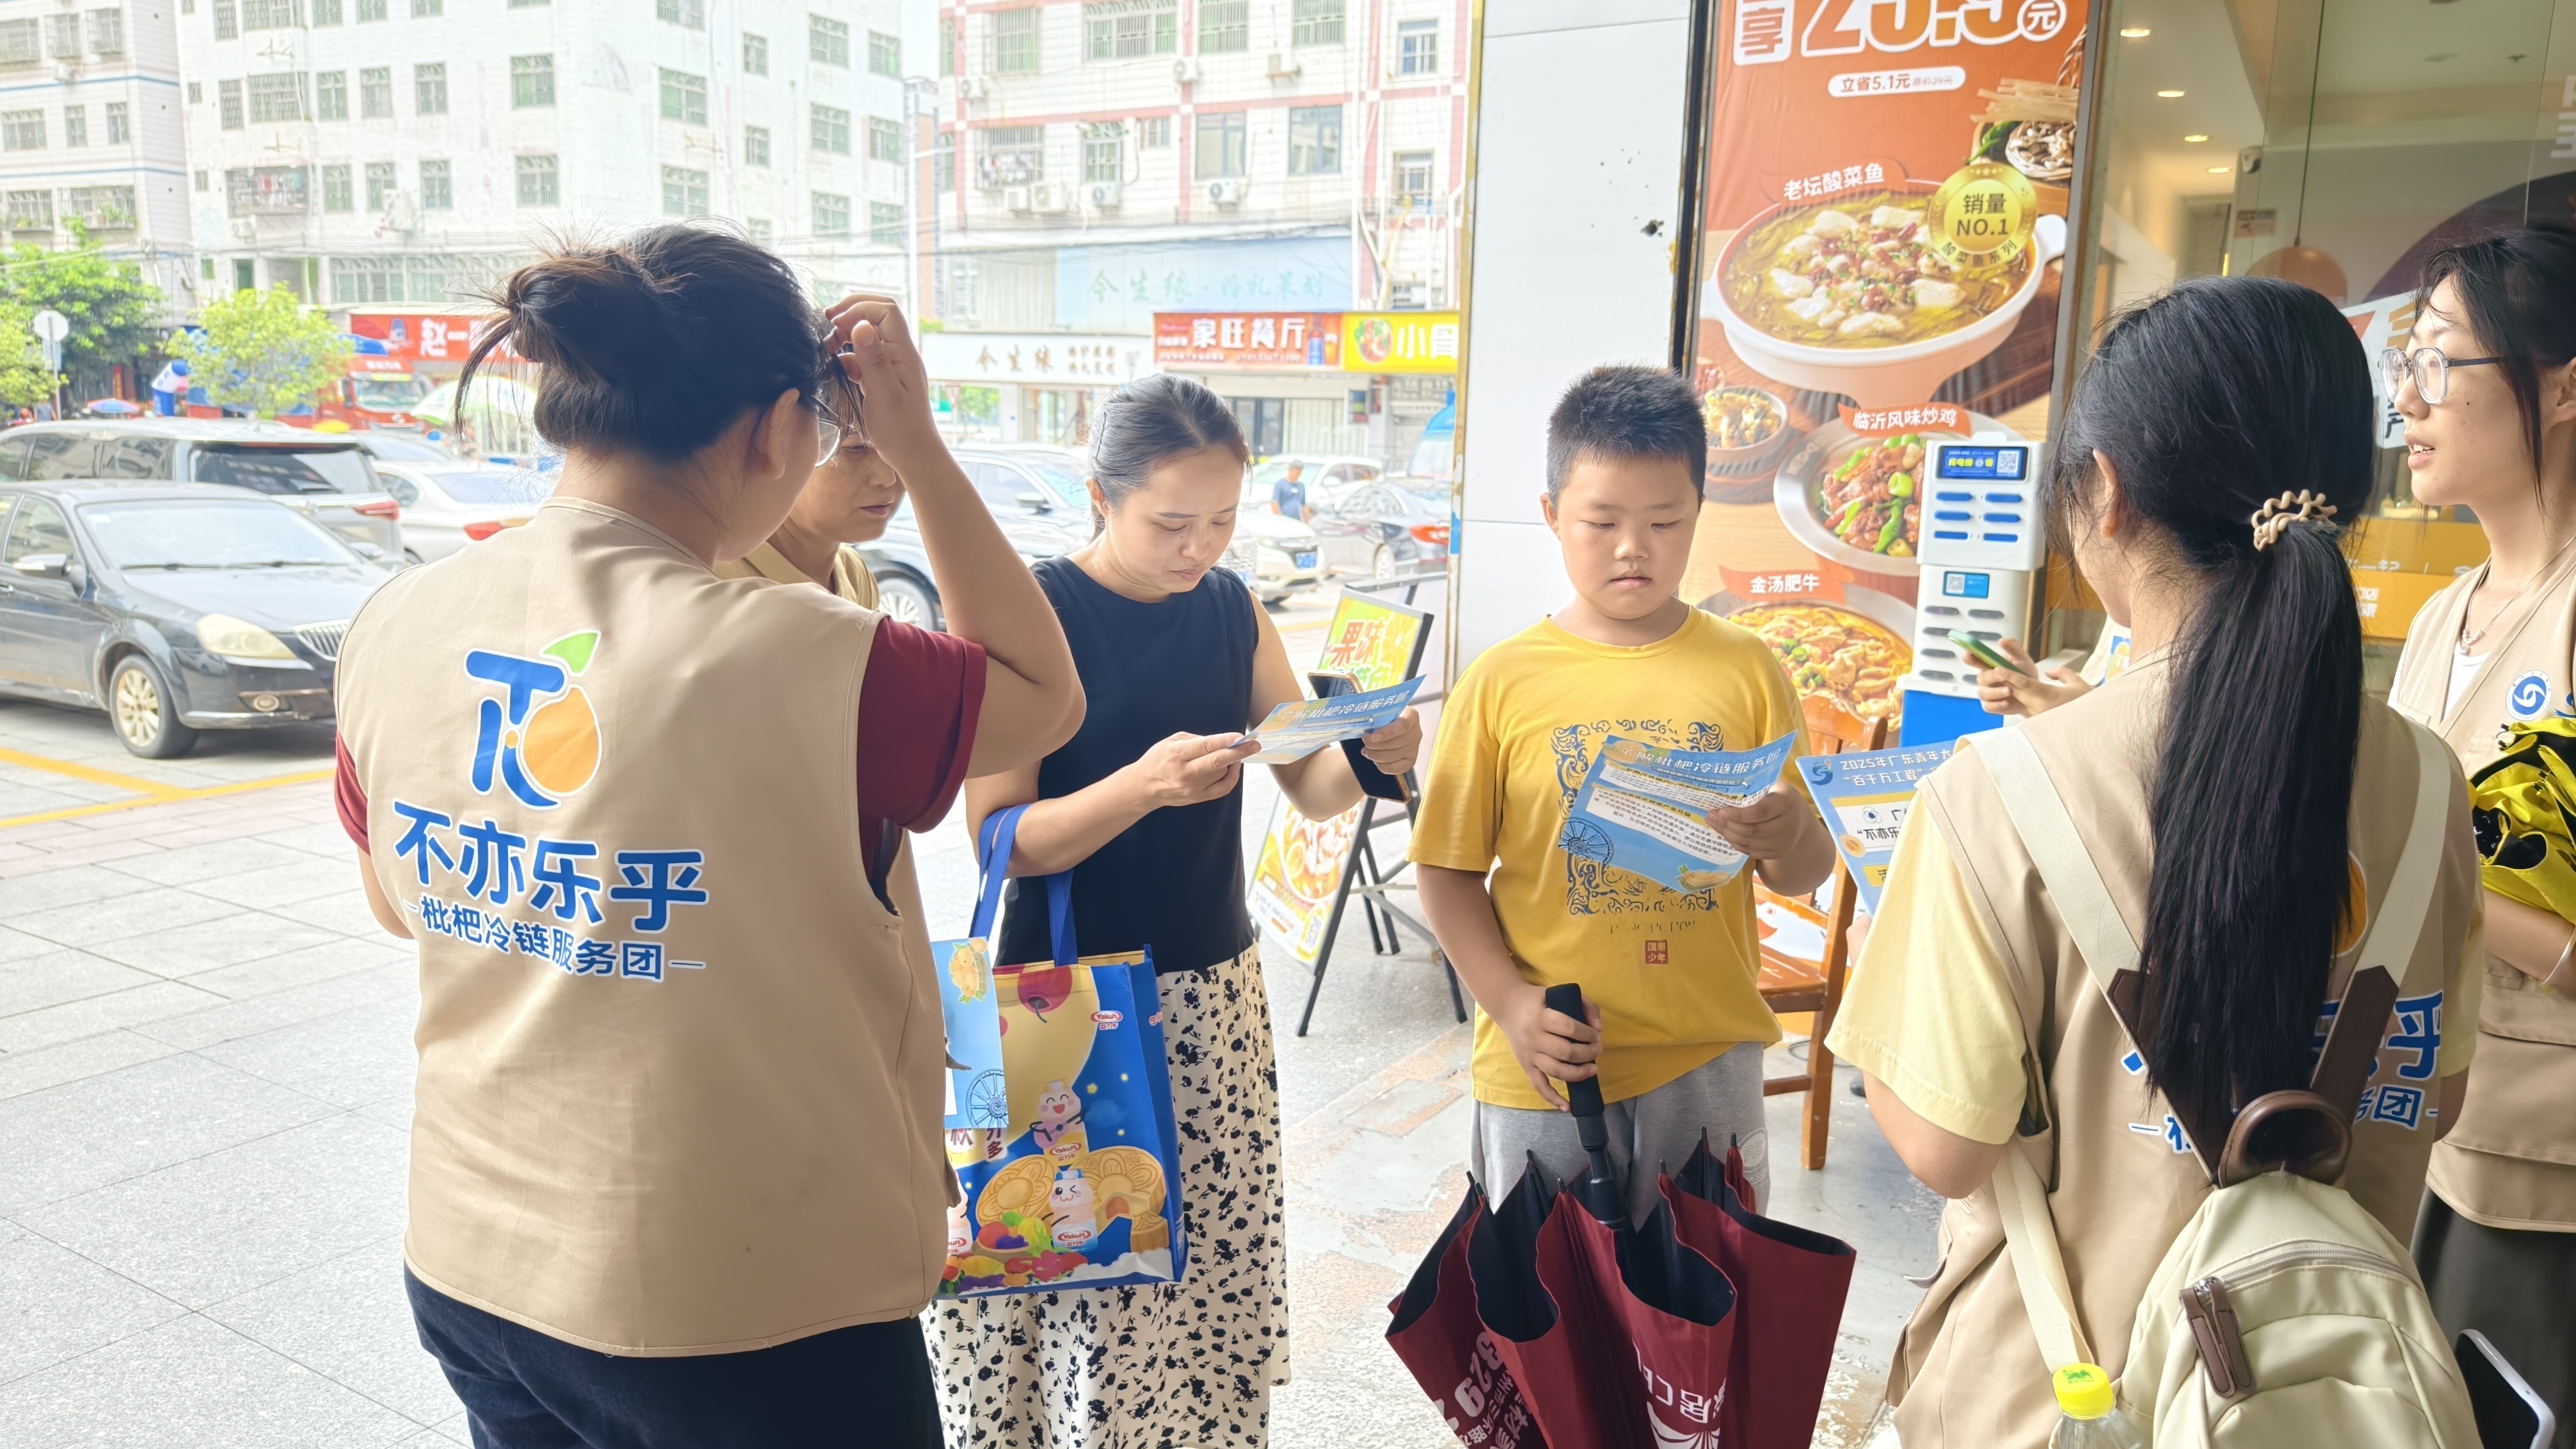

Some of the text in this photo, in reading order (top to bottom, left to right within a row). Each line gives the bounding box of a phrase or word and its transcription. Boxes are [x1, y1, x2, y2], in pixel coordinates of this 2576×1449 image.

[1841, 74, 1910, 92] 立省5.1元
[1784, 162, 1884, 201] 老坛酸菜鱼
[1963, 194, 2006, 214] 销量
[1957, 219, 2008, 236] NO.1
[1192, 318, 1306, 350] 家旺餐厅
[1853, 408, 1958, 430] 临沂风味炒鸡
[1750, 573, 1819, 594] 金汤肥牛
[1857, 826, 1899, 841] “不亦乐
[394, 801, 708, 932] 不亦乐乎
[420, 893, 665, 981] 枇杷冷链服务团
[1055, 1145, 1077, 1154] Yakult
[1062, 1231, 1087, 1240] Yakult
